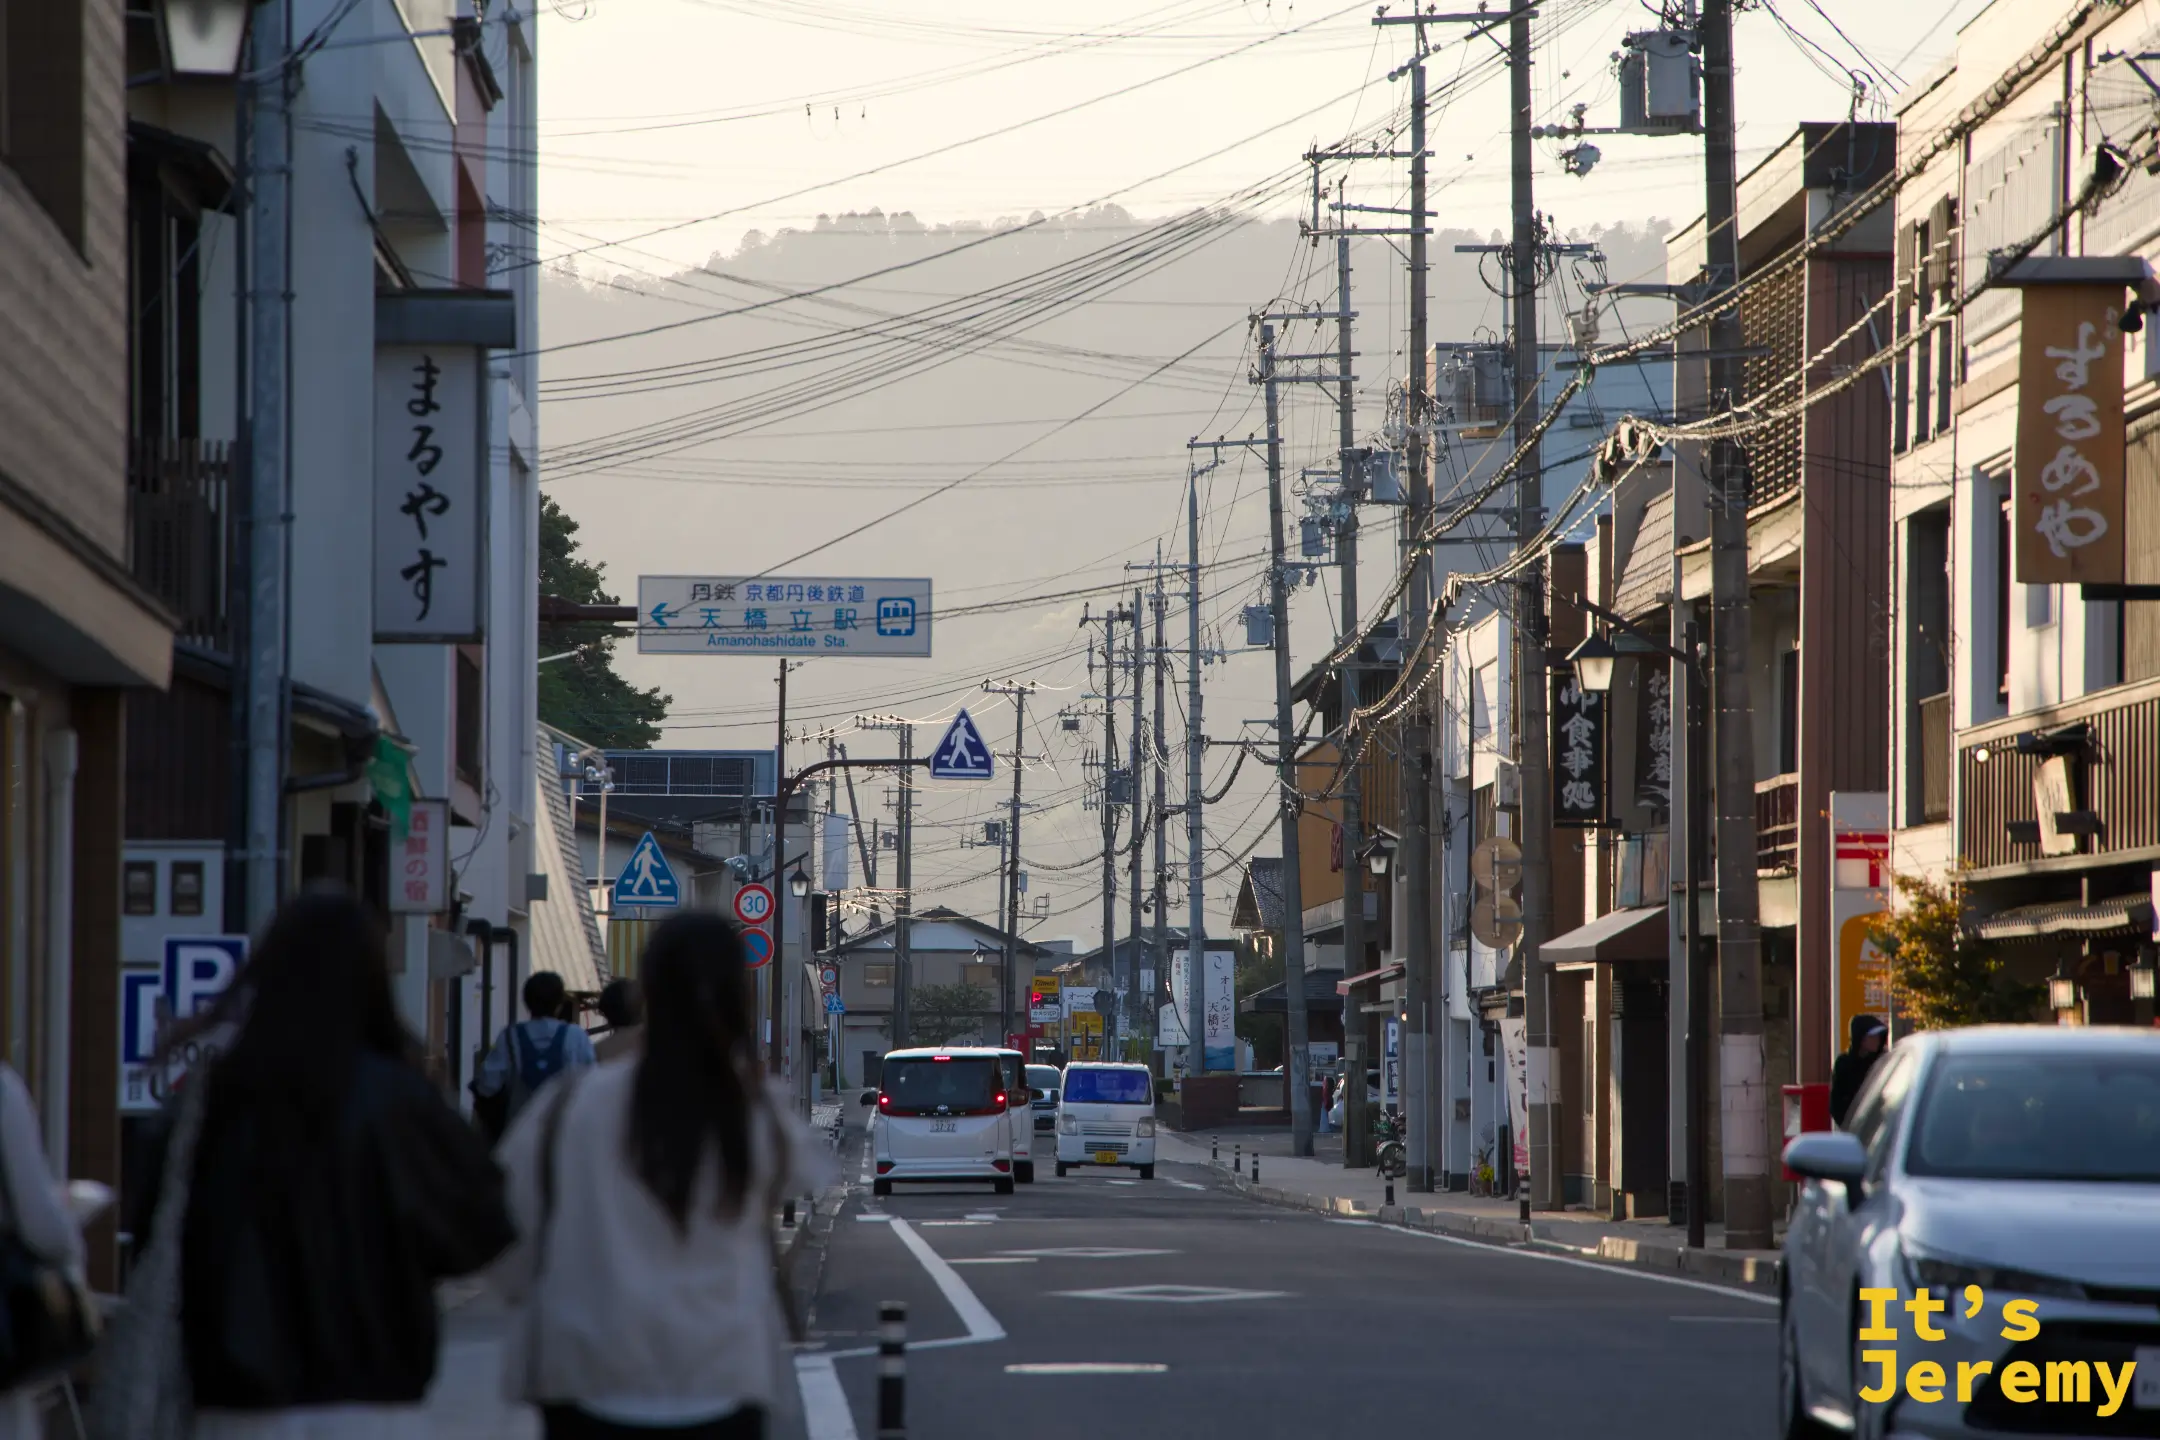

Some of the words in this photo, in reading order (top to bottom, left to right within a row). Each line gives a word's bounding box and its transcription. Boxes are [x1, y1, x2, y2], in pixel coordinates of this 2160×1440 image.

[400, 354, 450, 622] まるやす
[691, 583, 736, 601] 丹鉄
[745, 584, 866, 603] 京都丹後鉄道
[699, 607, 858, 632] 天橋立駅
[707, 634, 816, 648] Amanohashidate
[824, 635, 849, 647] Sta.
[743, 895, 766, 914] 30
[175, 945, 236, 1019] P
[824, 971, 834, 981] 40
[1220, 975, 1231, 1031] オーベルジュ
[1207, 1001, 1220, 1038] 天橋立
